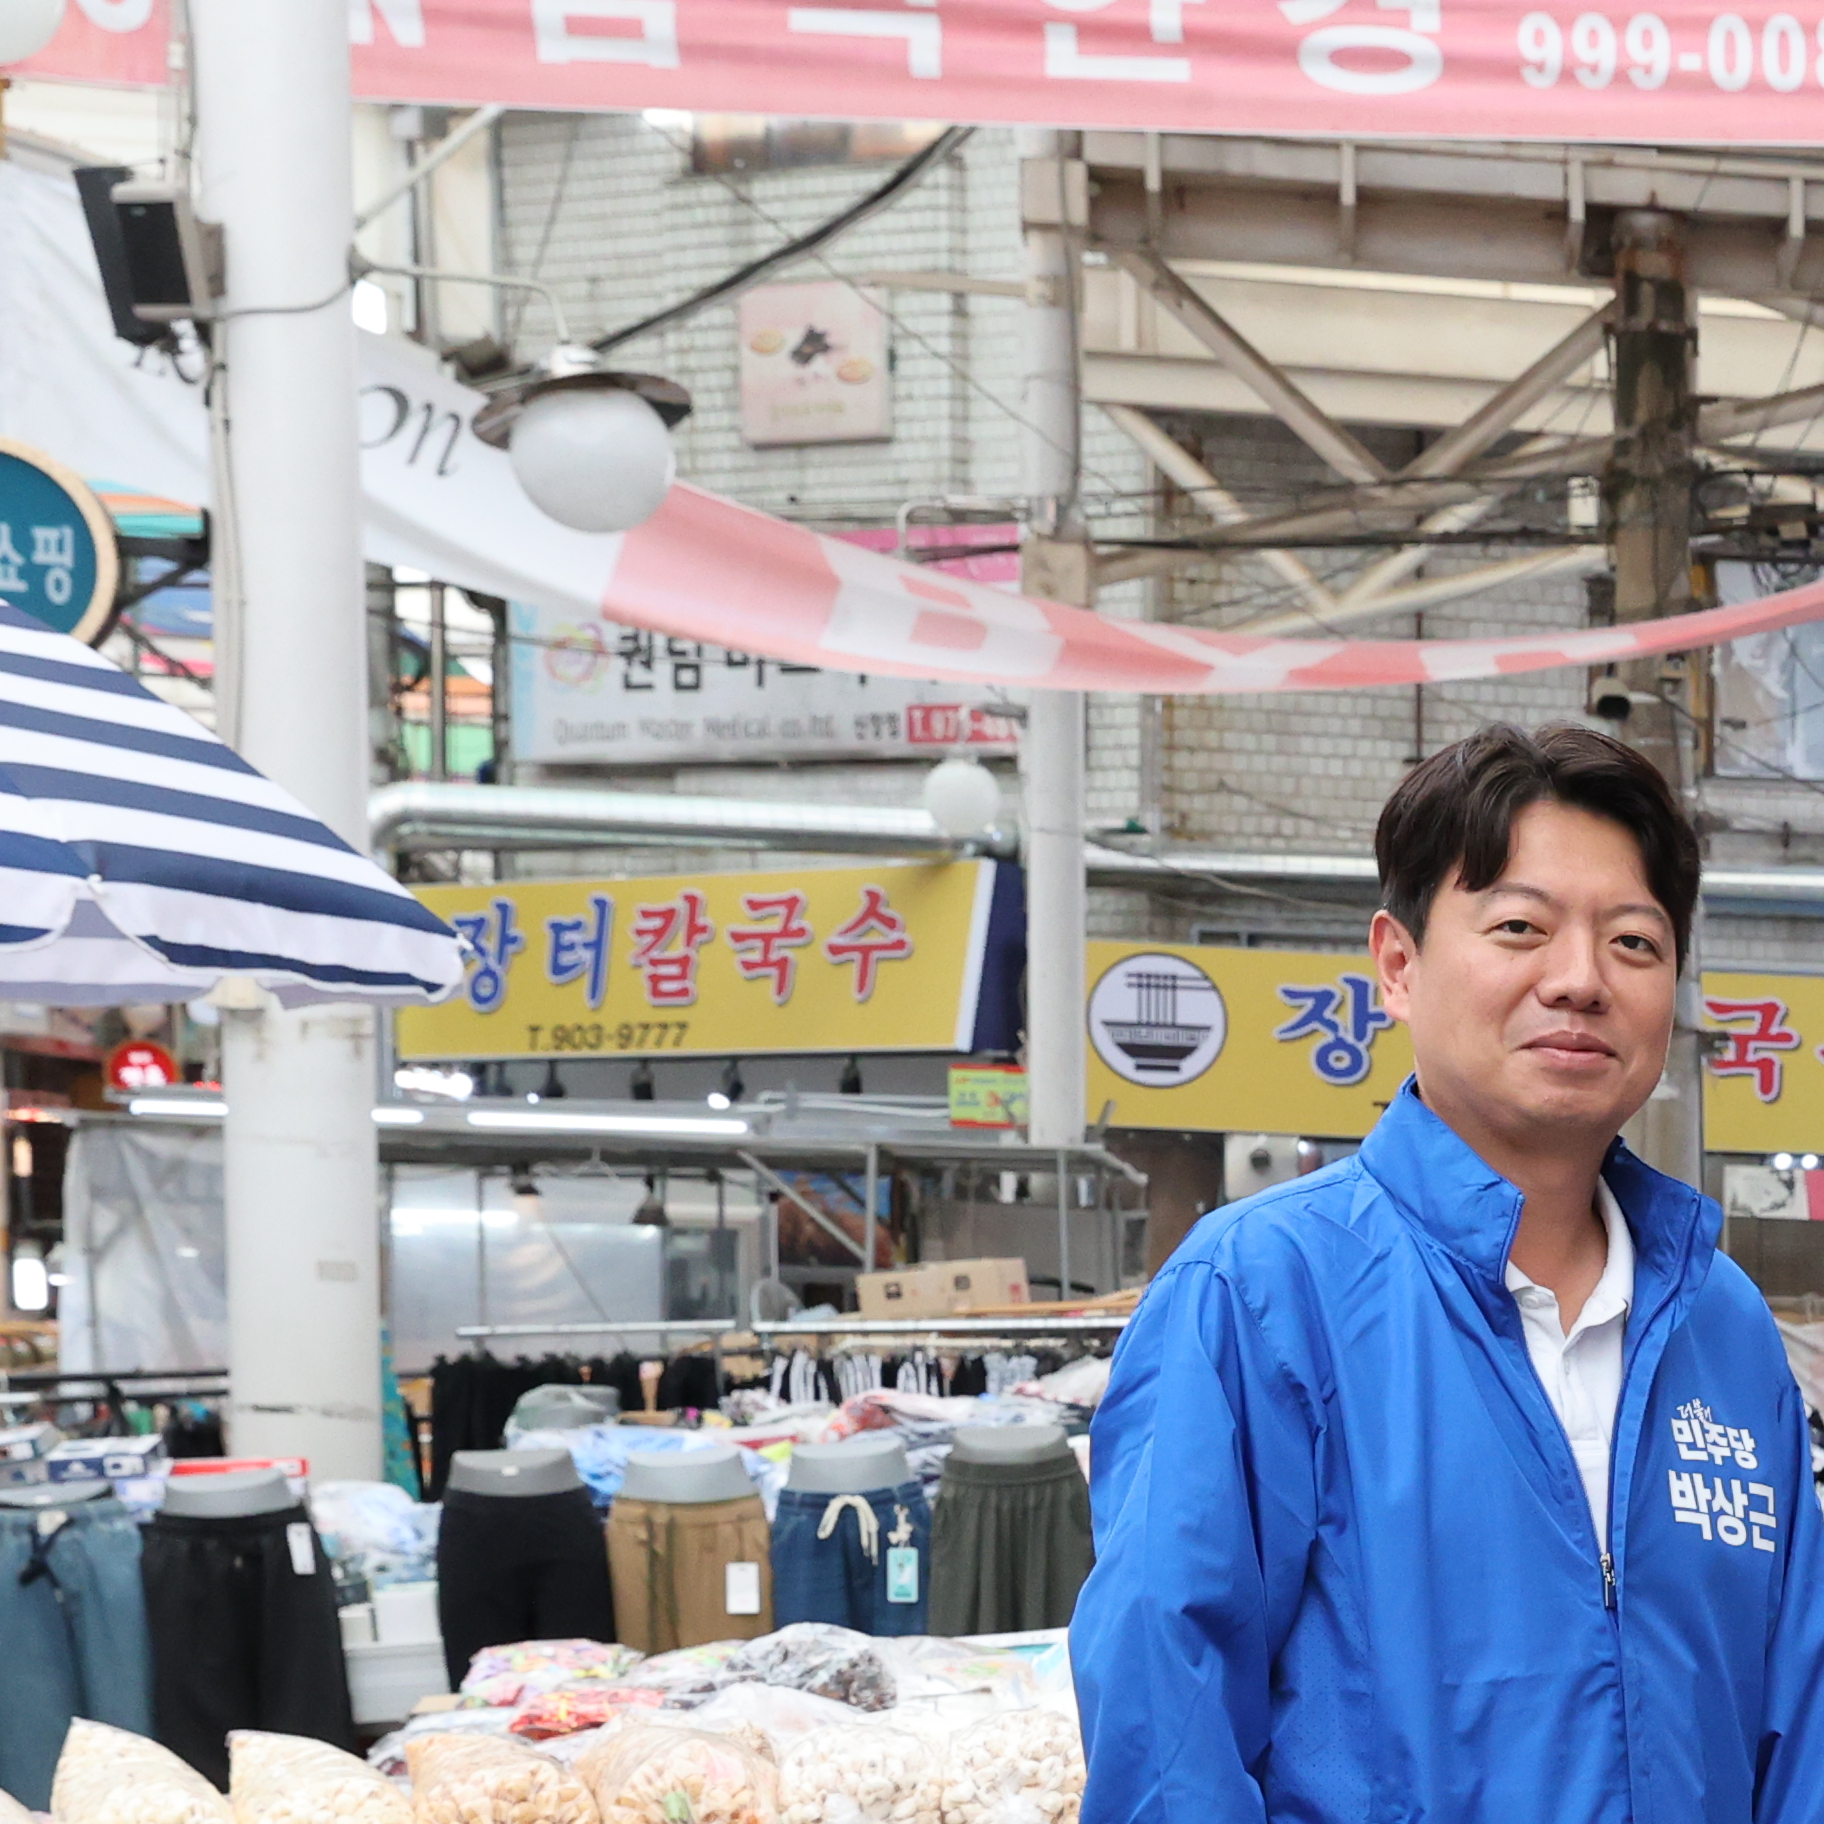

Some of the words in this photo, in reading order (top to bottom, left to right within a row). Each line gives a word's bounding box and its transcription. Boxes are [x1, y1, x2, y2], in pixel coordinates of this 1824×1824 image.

[526, 1020, 691, 1052] T.903-9777
[1677, 1397, 1713, 1425] 더불어
[1669, 1417, 1757, 1472] 민주당
[1667, 1468, 1778, 1553] 박상근
